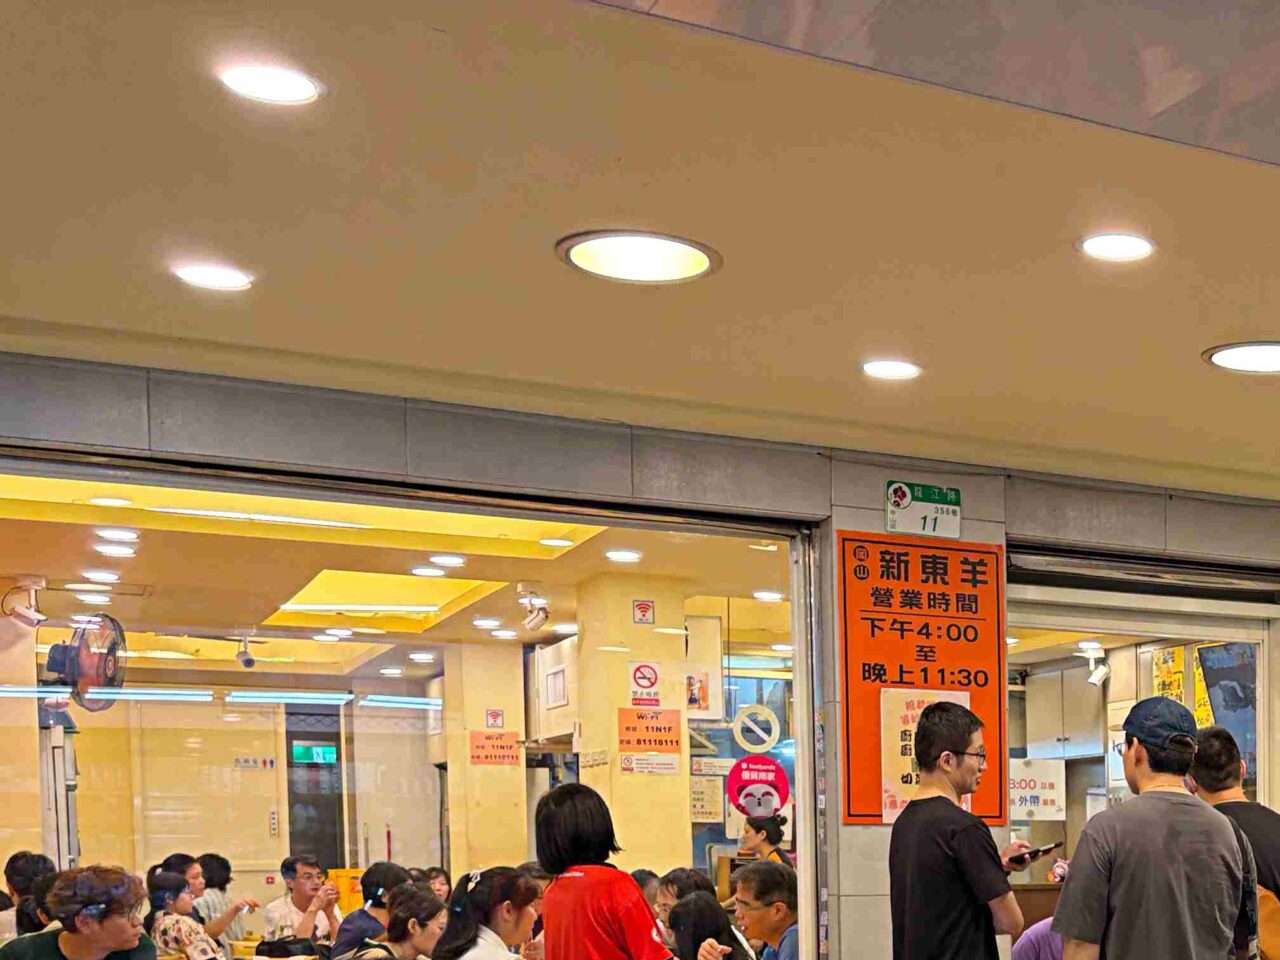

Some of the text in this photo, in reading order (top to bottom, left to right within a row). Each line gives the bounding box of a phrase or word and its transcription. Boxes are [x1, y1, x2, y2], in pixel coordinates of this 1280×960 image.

[921, 515, 938, 532] 11
[879, 550, 989, 588] 新東羊
[870, 586, 979, 615] 營業時間
[860, 617, 979, 643] 下午4:00
[915, 645, 937, 663] 至
[862, 662, 989, 688] 晚上11:30
